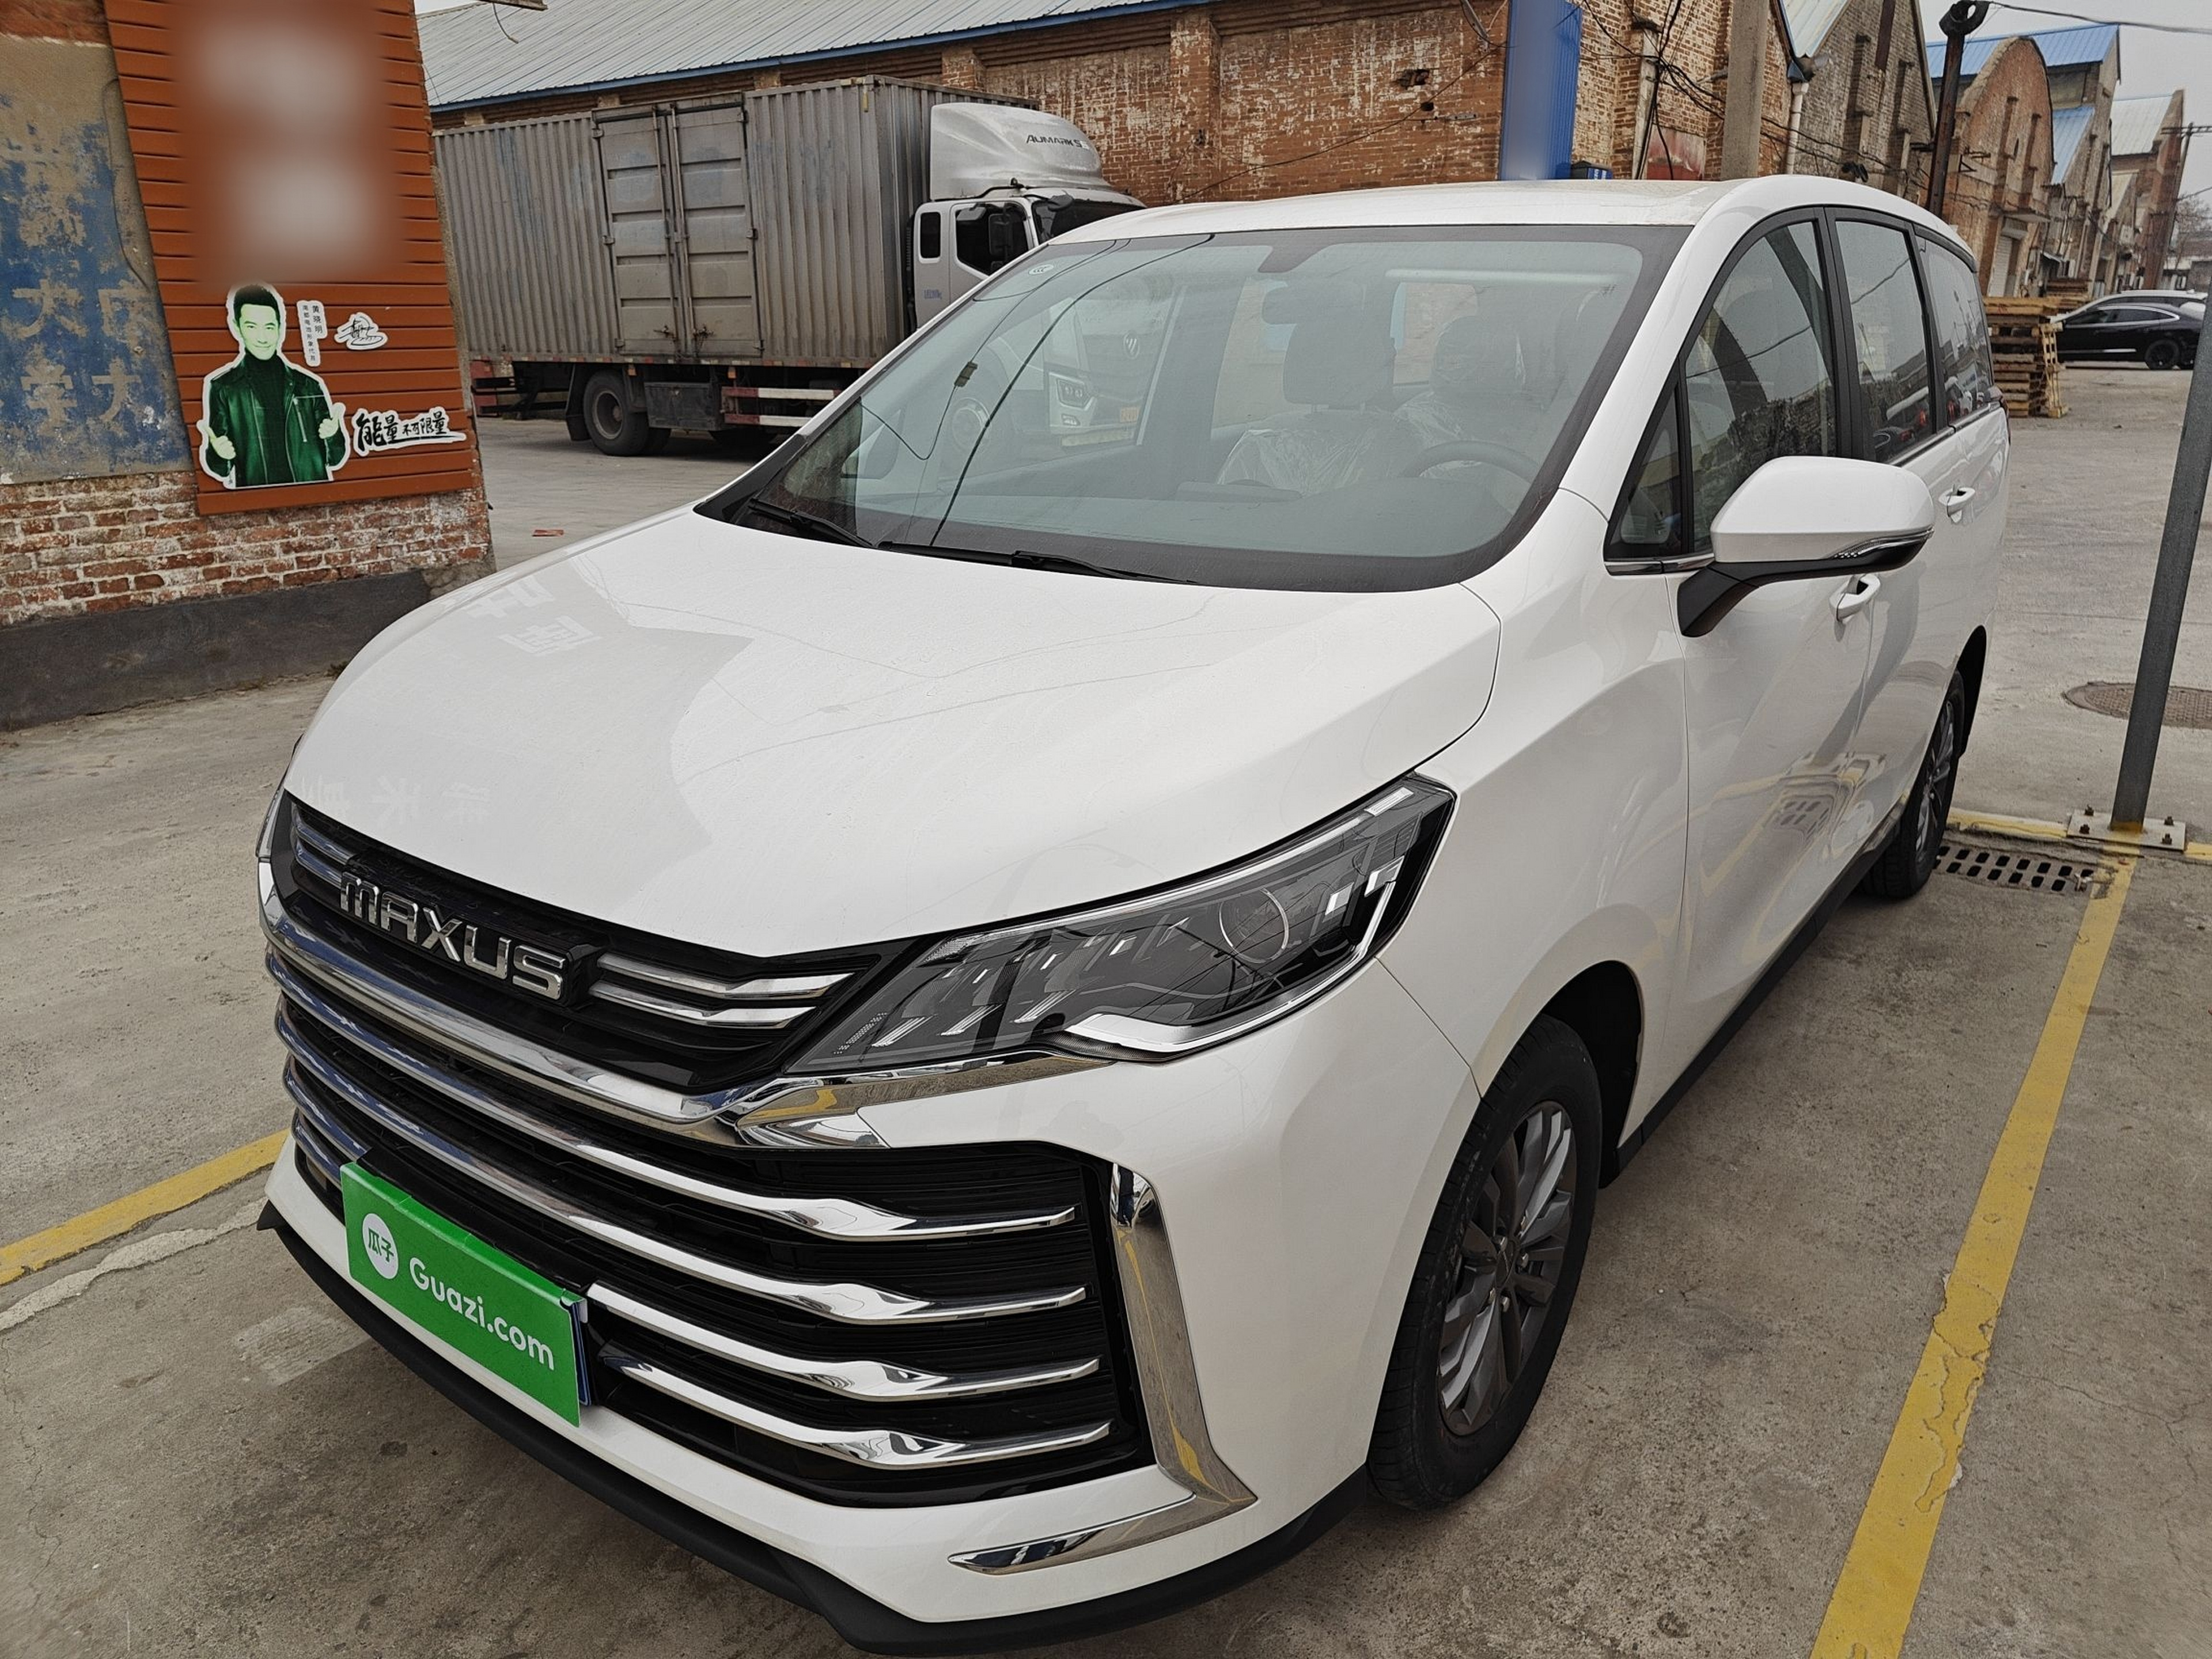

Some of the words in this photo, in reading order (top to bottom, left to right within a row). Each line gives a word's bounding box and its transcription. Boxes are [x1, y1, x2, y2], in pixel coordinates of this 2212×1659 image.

[312, 305, 323, 335] 黄晓明
[340, 872, 566, 1001] MAXUS
[368, 1228, 394, 1262] 瓜子
[410, 1257, 555, 1370] Guazi.com
